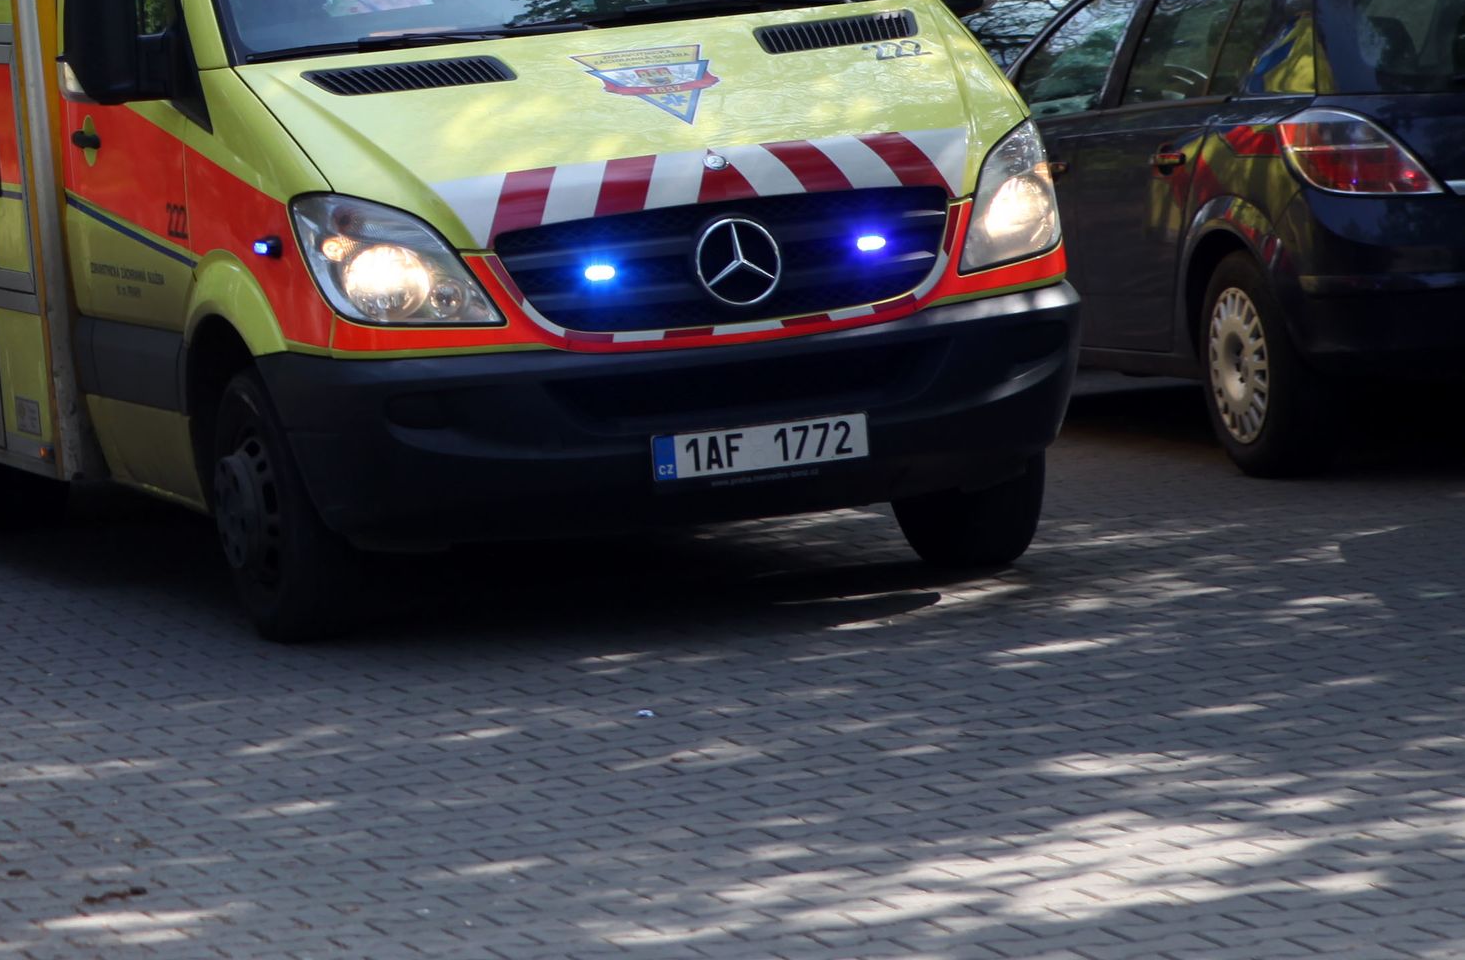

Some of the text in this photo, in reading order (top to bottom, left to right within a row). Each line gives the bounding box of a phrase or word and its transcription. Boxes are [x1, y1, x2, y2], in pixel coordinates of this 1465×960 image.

[685, 421, 853, 472] 1AF 1772
[658, 464, 674, 476] CZ
